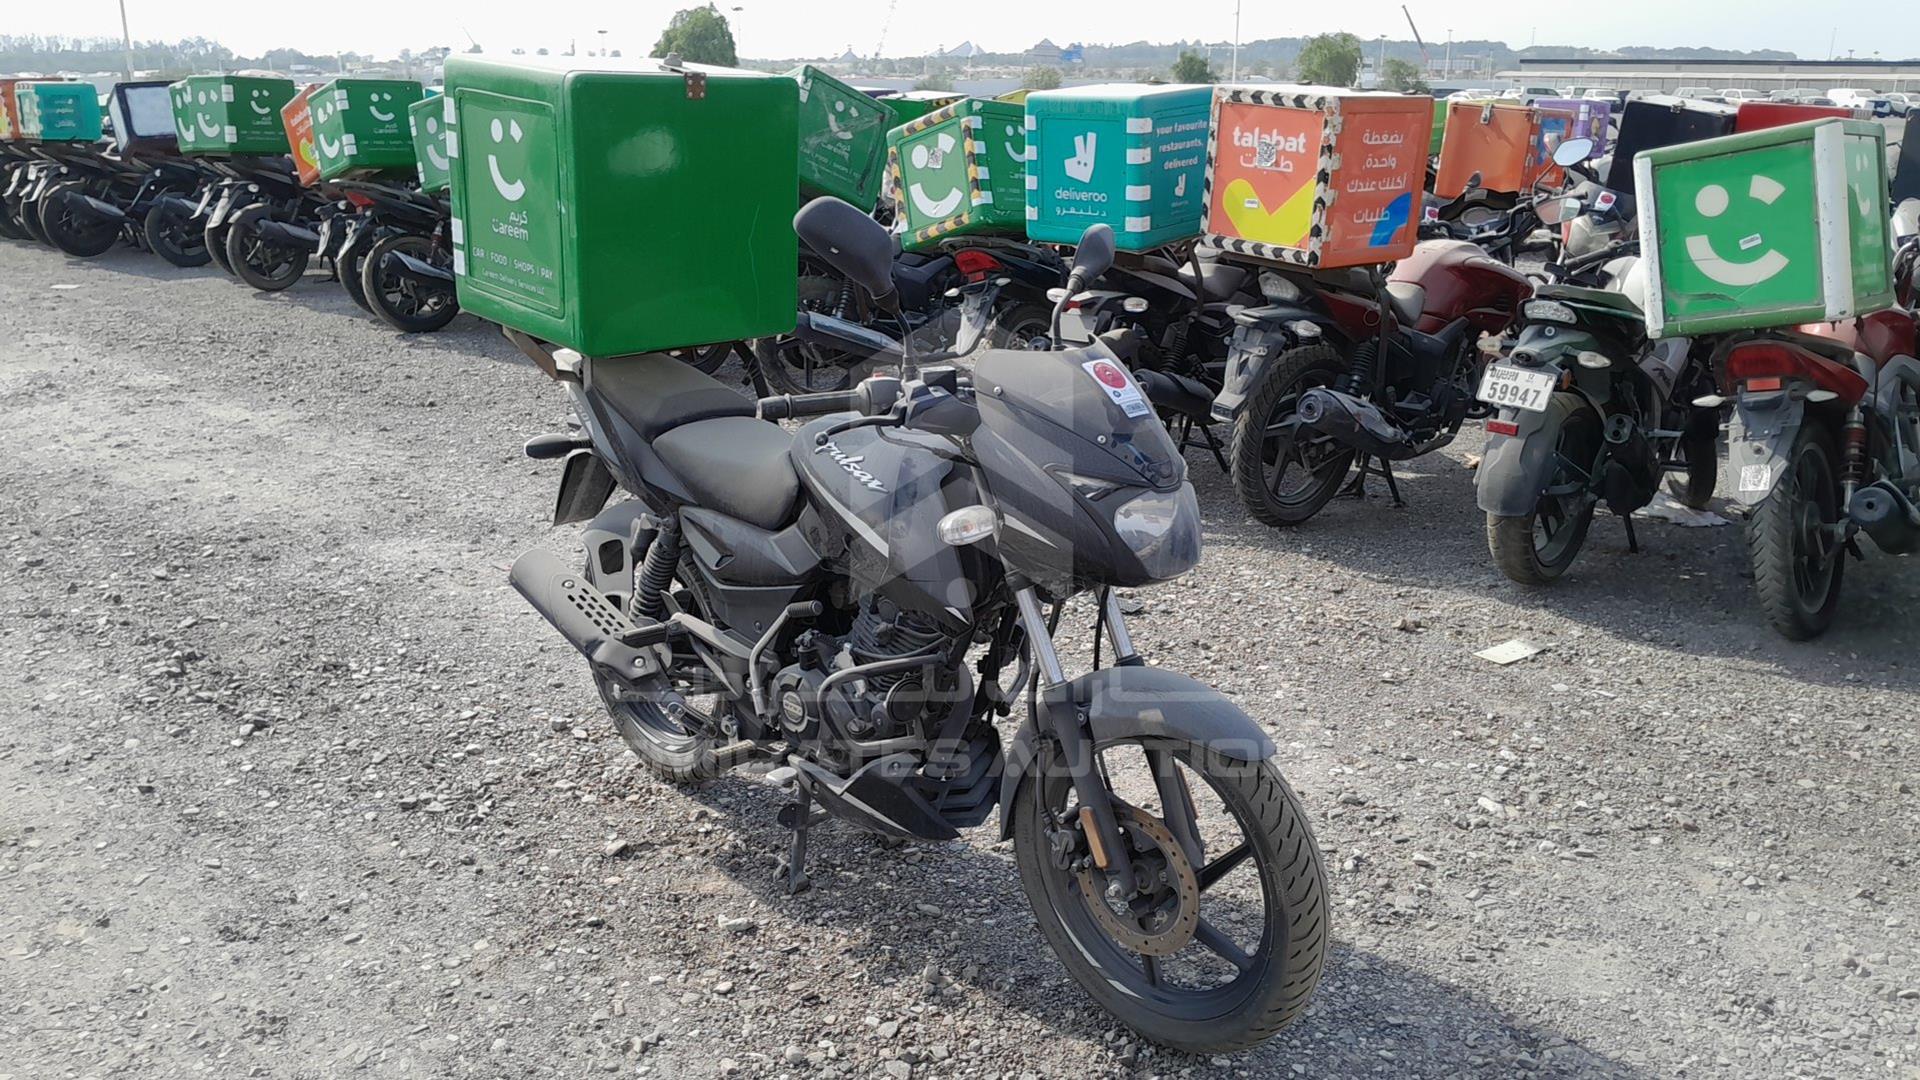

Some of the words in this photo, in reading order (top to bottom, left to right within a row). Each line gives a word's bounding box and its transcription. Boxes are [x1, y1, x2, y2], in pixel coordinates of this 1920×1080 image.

[1156, 126, 1172, 138] your
[1175, 119, 1207, 132] favourite
[1363, 129, 1403, 147] بضغطة
[1164, 155, 1199, 170] delivered
[1055, 186, 1108, 203] deliveroo
[1347, 178, 1377, 193] عندك
[509, 210, 528, 226] كريم
[1353, 207, 1391, 226] طلبات
[491, 218, 529, 241] Careem
[472, 246, 485, 258] CAR
[490, 251, 508, 266] FOOD
[513, 258, 535, 274] SHOPS
[540, 267, 553, 280] PAY
[1487, 381, 1542, 407] 59947
